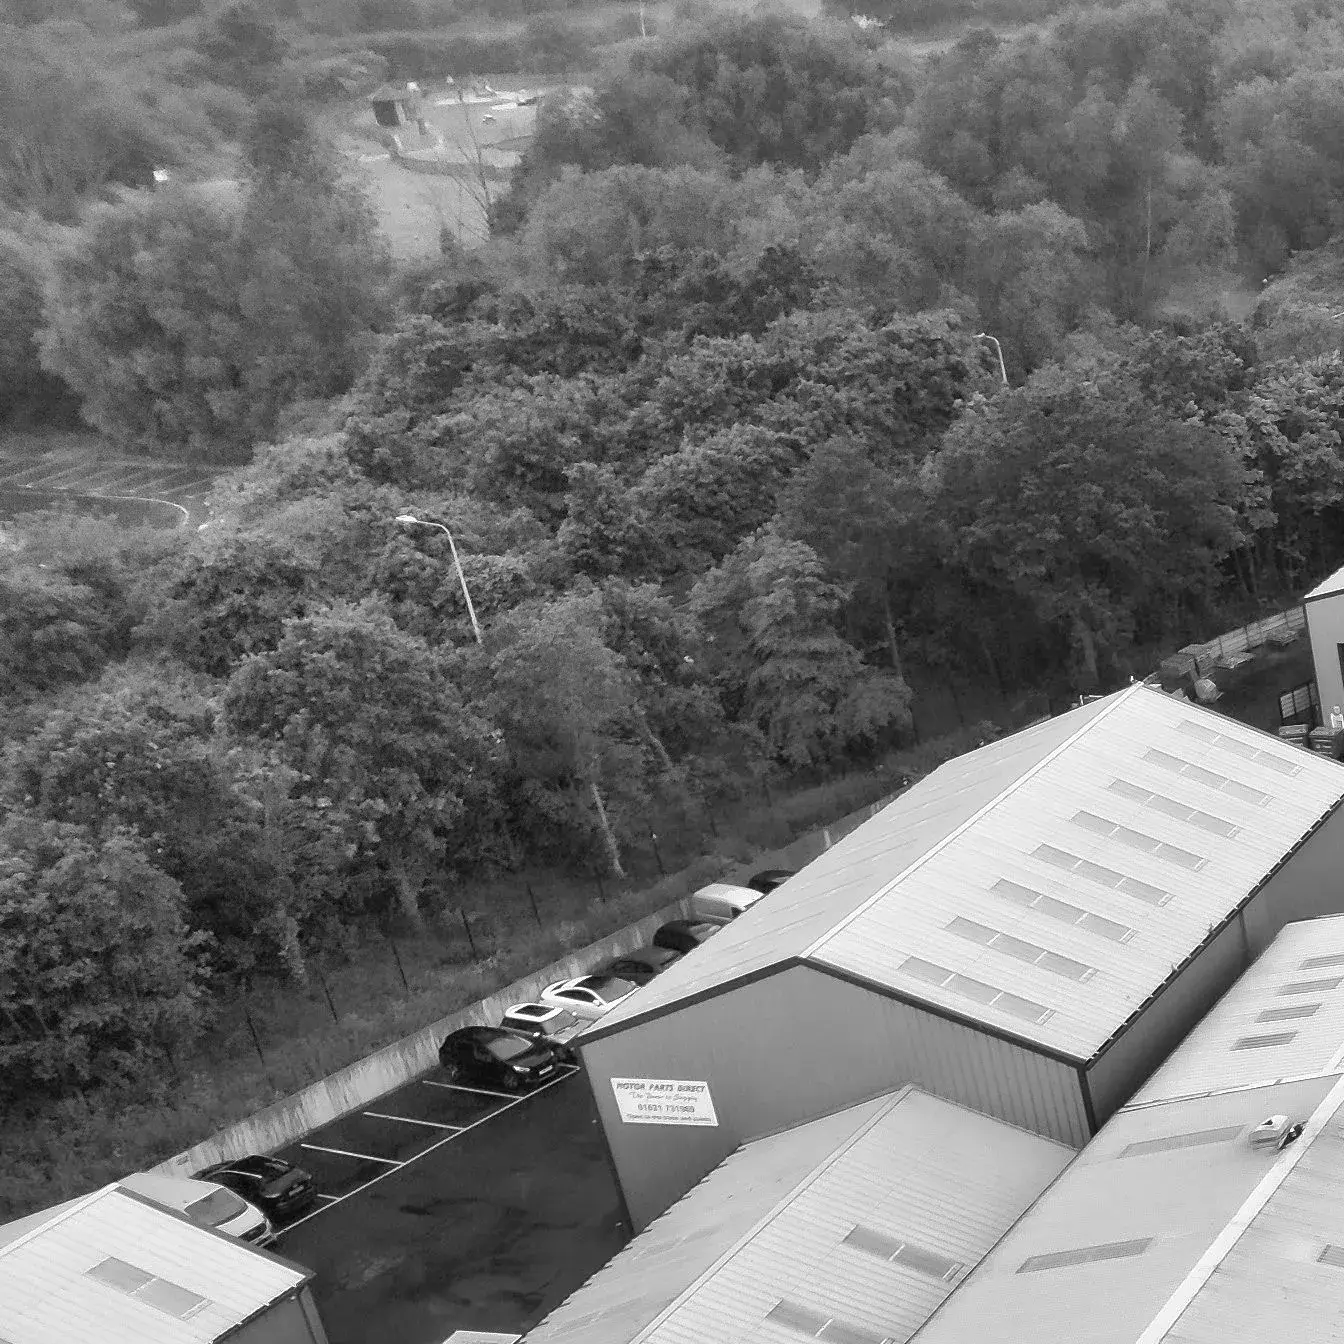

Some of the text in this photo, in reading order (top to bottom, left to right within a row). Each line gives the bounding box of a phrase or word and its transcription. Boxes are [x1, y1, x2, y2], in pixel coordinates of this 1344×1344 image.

[616, 1082, 706, 1092] MOTOR PARTS DIRECT
